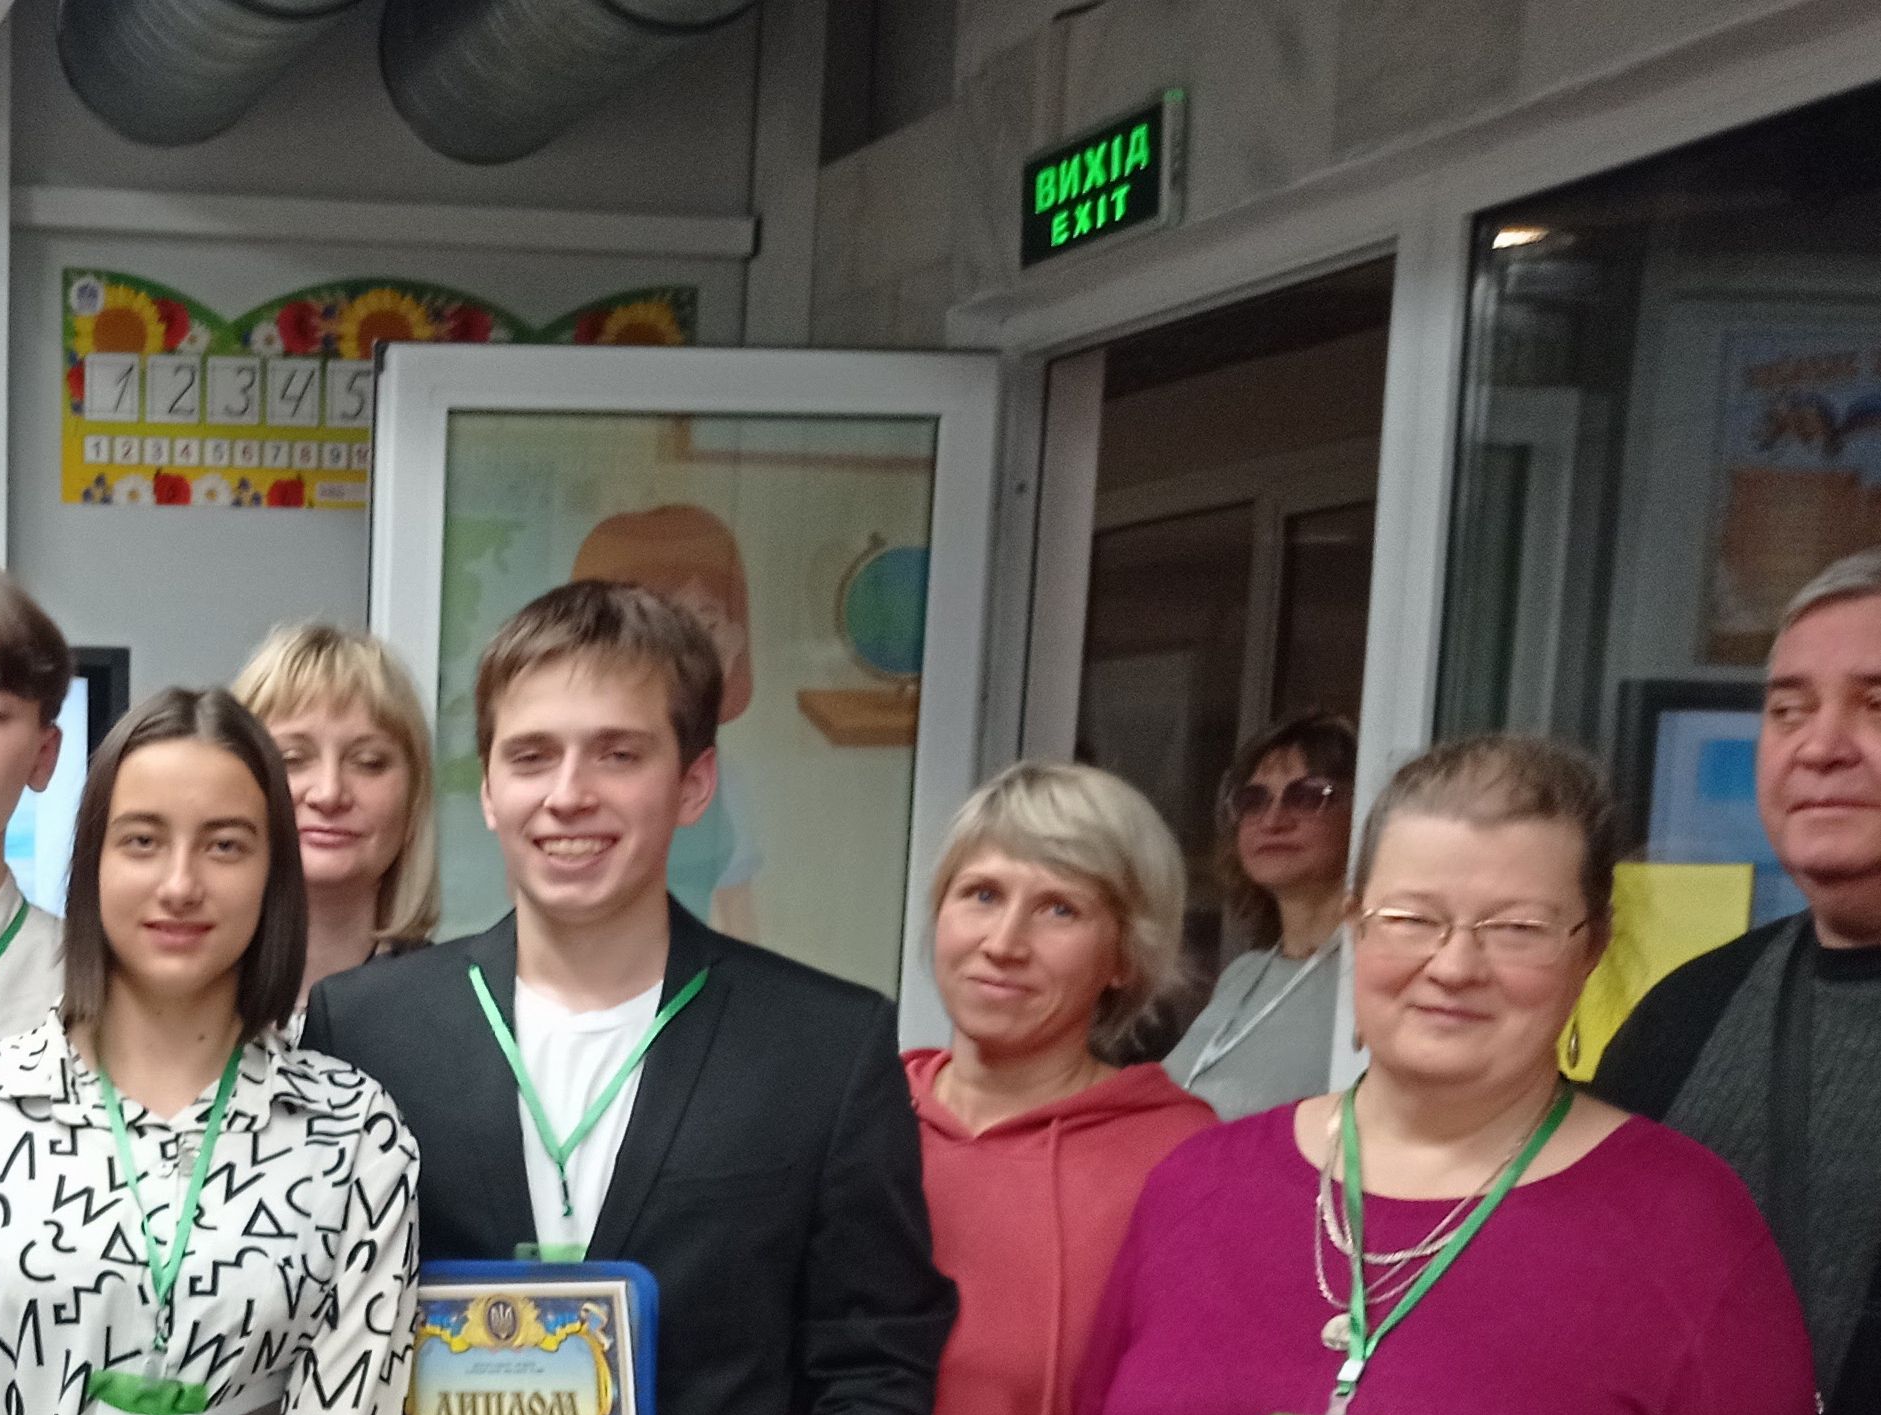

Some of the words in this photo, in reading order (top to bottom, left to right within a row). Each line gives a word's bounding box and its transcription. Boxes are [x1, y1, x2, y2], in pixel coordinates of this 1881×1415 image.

[1034, 122, 1151, 215] ВИХІД
[1050, 182, 1132, 247] EXIT
[114, 363, 135, 413] 1
[167, 363, 197, 415] 2
[224, 366, 257, 417] 3
[279, 367, 317, 417] 4
[340, 369, 372, 420] 5
